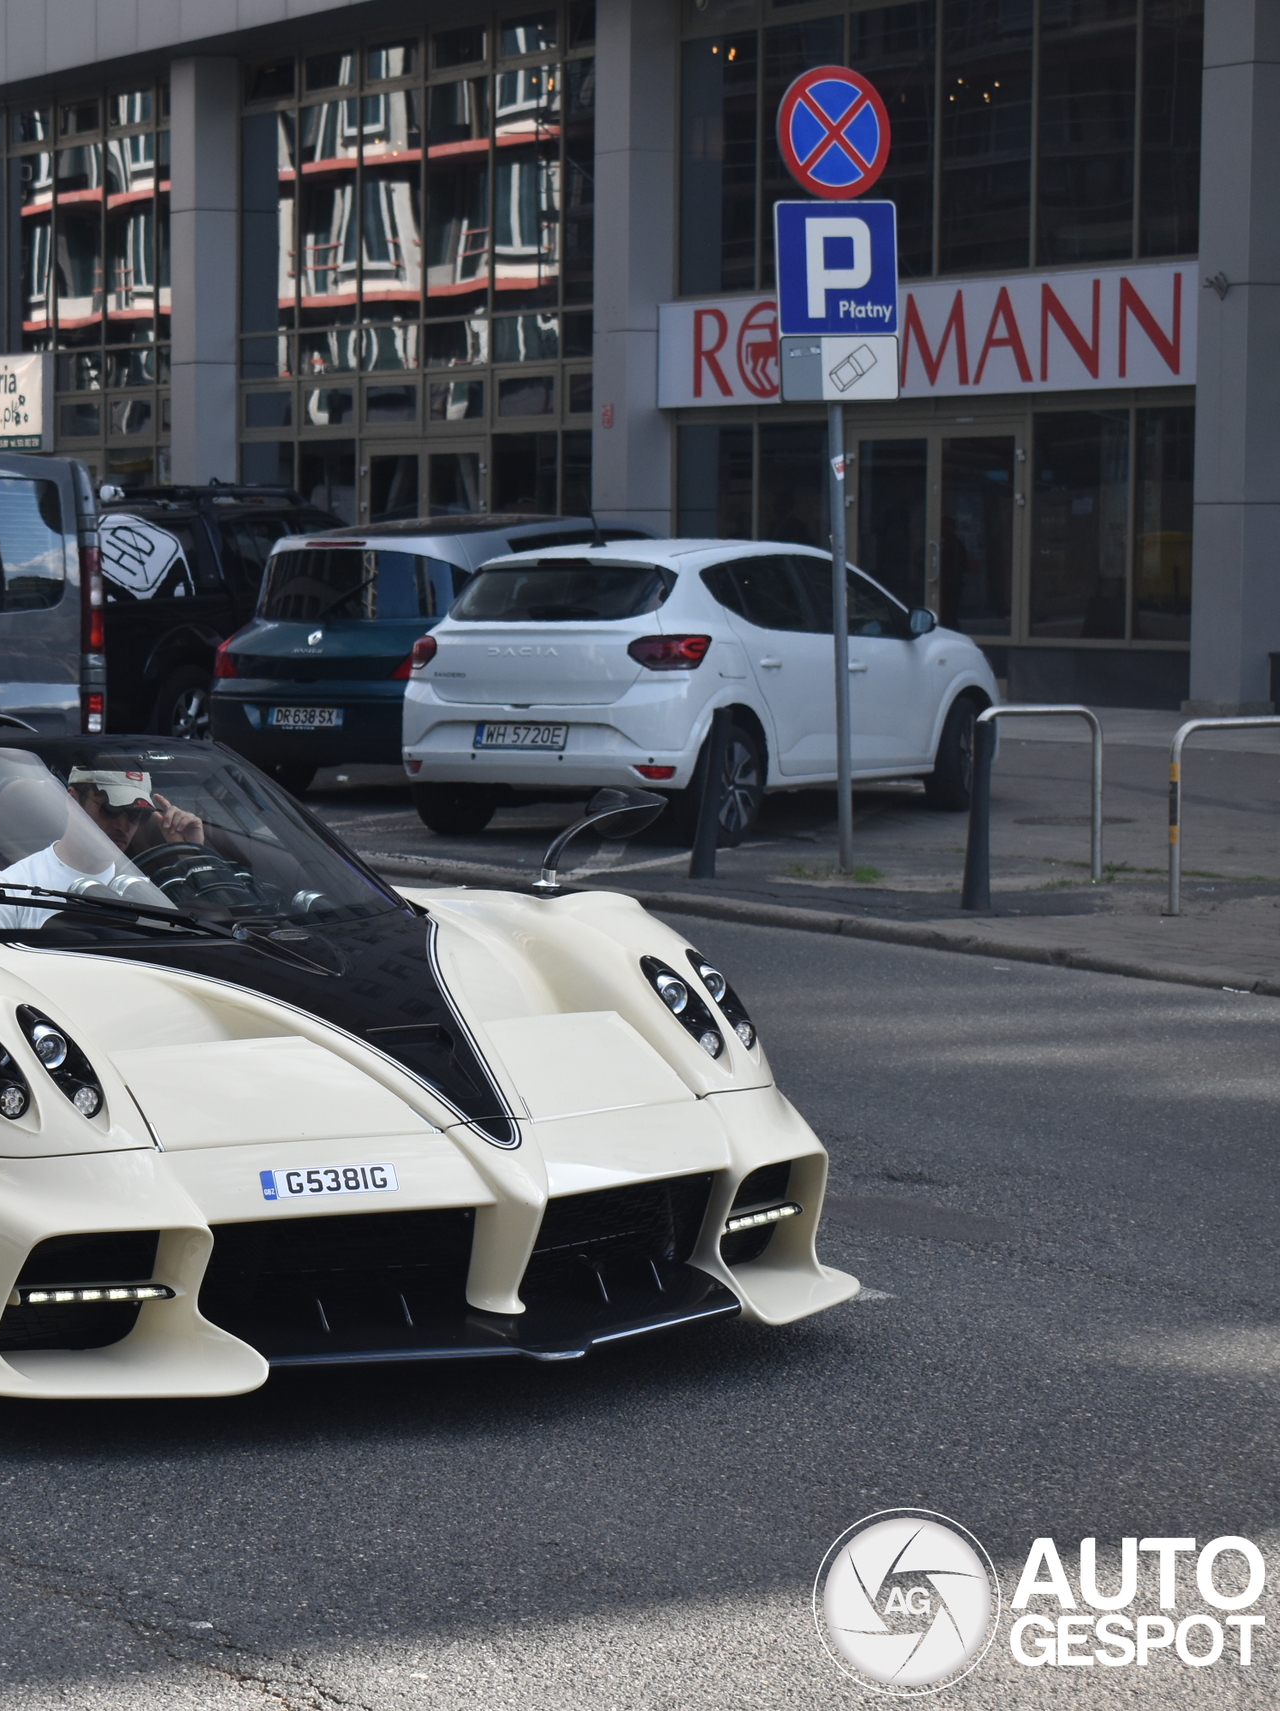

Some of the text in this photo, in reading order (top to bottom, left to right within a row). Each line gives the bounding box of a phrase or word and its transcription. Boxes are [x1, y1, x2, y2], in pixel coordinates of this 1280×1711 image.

[805, 217, 871, 318] P
[839, 301, 893, 323] Płatny
[693, 272, 1182, 398] ROMANN
[487, 646, 559, 657] DACIA
[434, 671, 467, 679] SANDERO
[485, 726, 562, 745] WH 5720E
